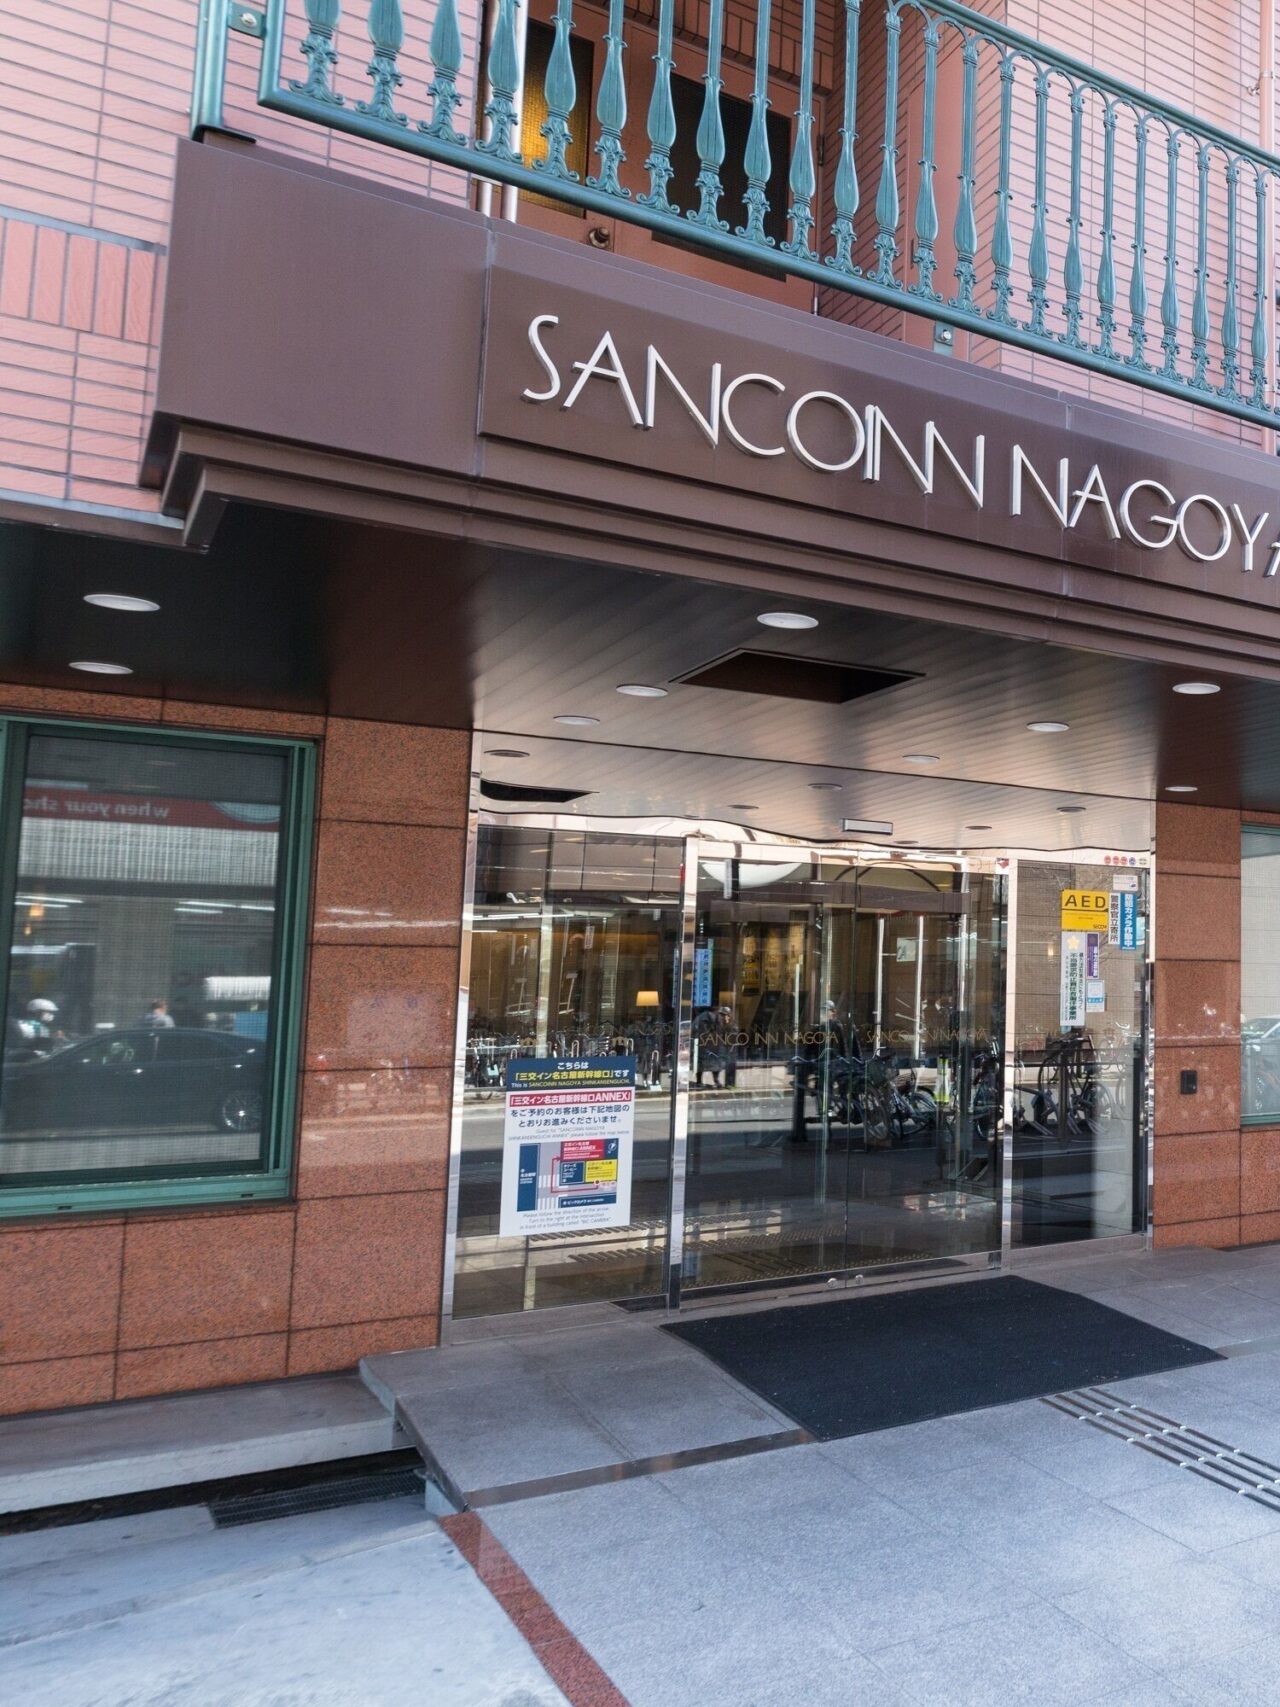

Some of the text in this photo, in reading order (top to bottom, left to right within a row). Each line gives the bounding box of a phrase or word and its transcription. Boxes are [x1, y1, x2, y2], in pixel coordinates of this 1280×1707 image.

[1064, 894, 1106, 908] AED
[1110, 894, 1119, 943] 警察官立寄所
[699, 1031, 750, 1046] SANCO
[754, 1031, 779, 1045] INN
[557, 1062, 589, 1070] こちらは
[511, 1104, 630, 1118] をご予約のお客様は下記地図の
